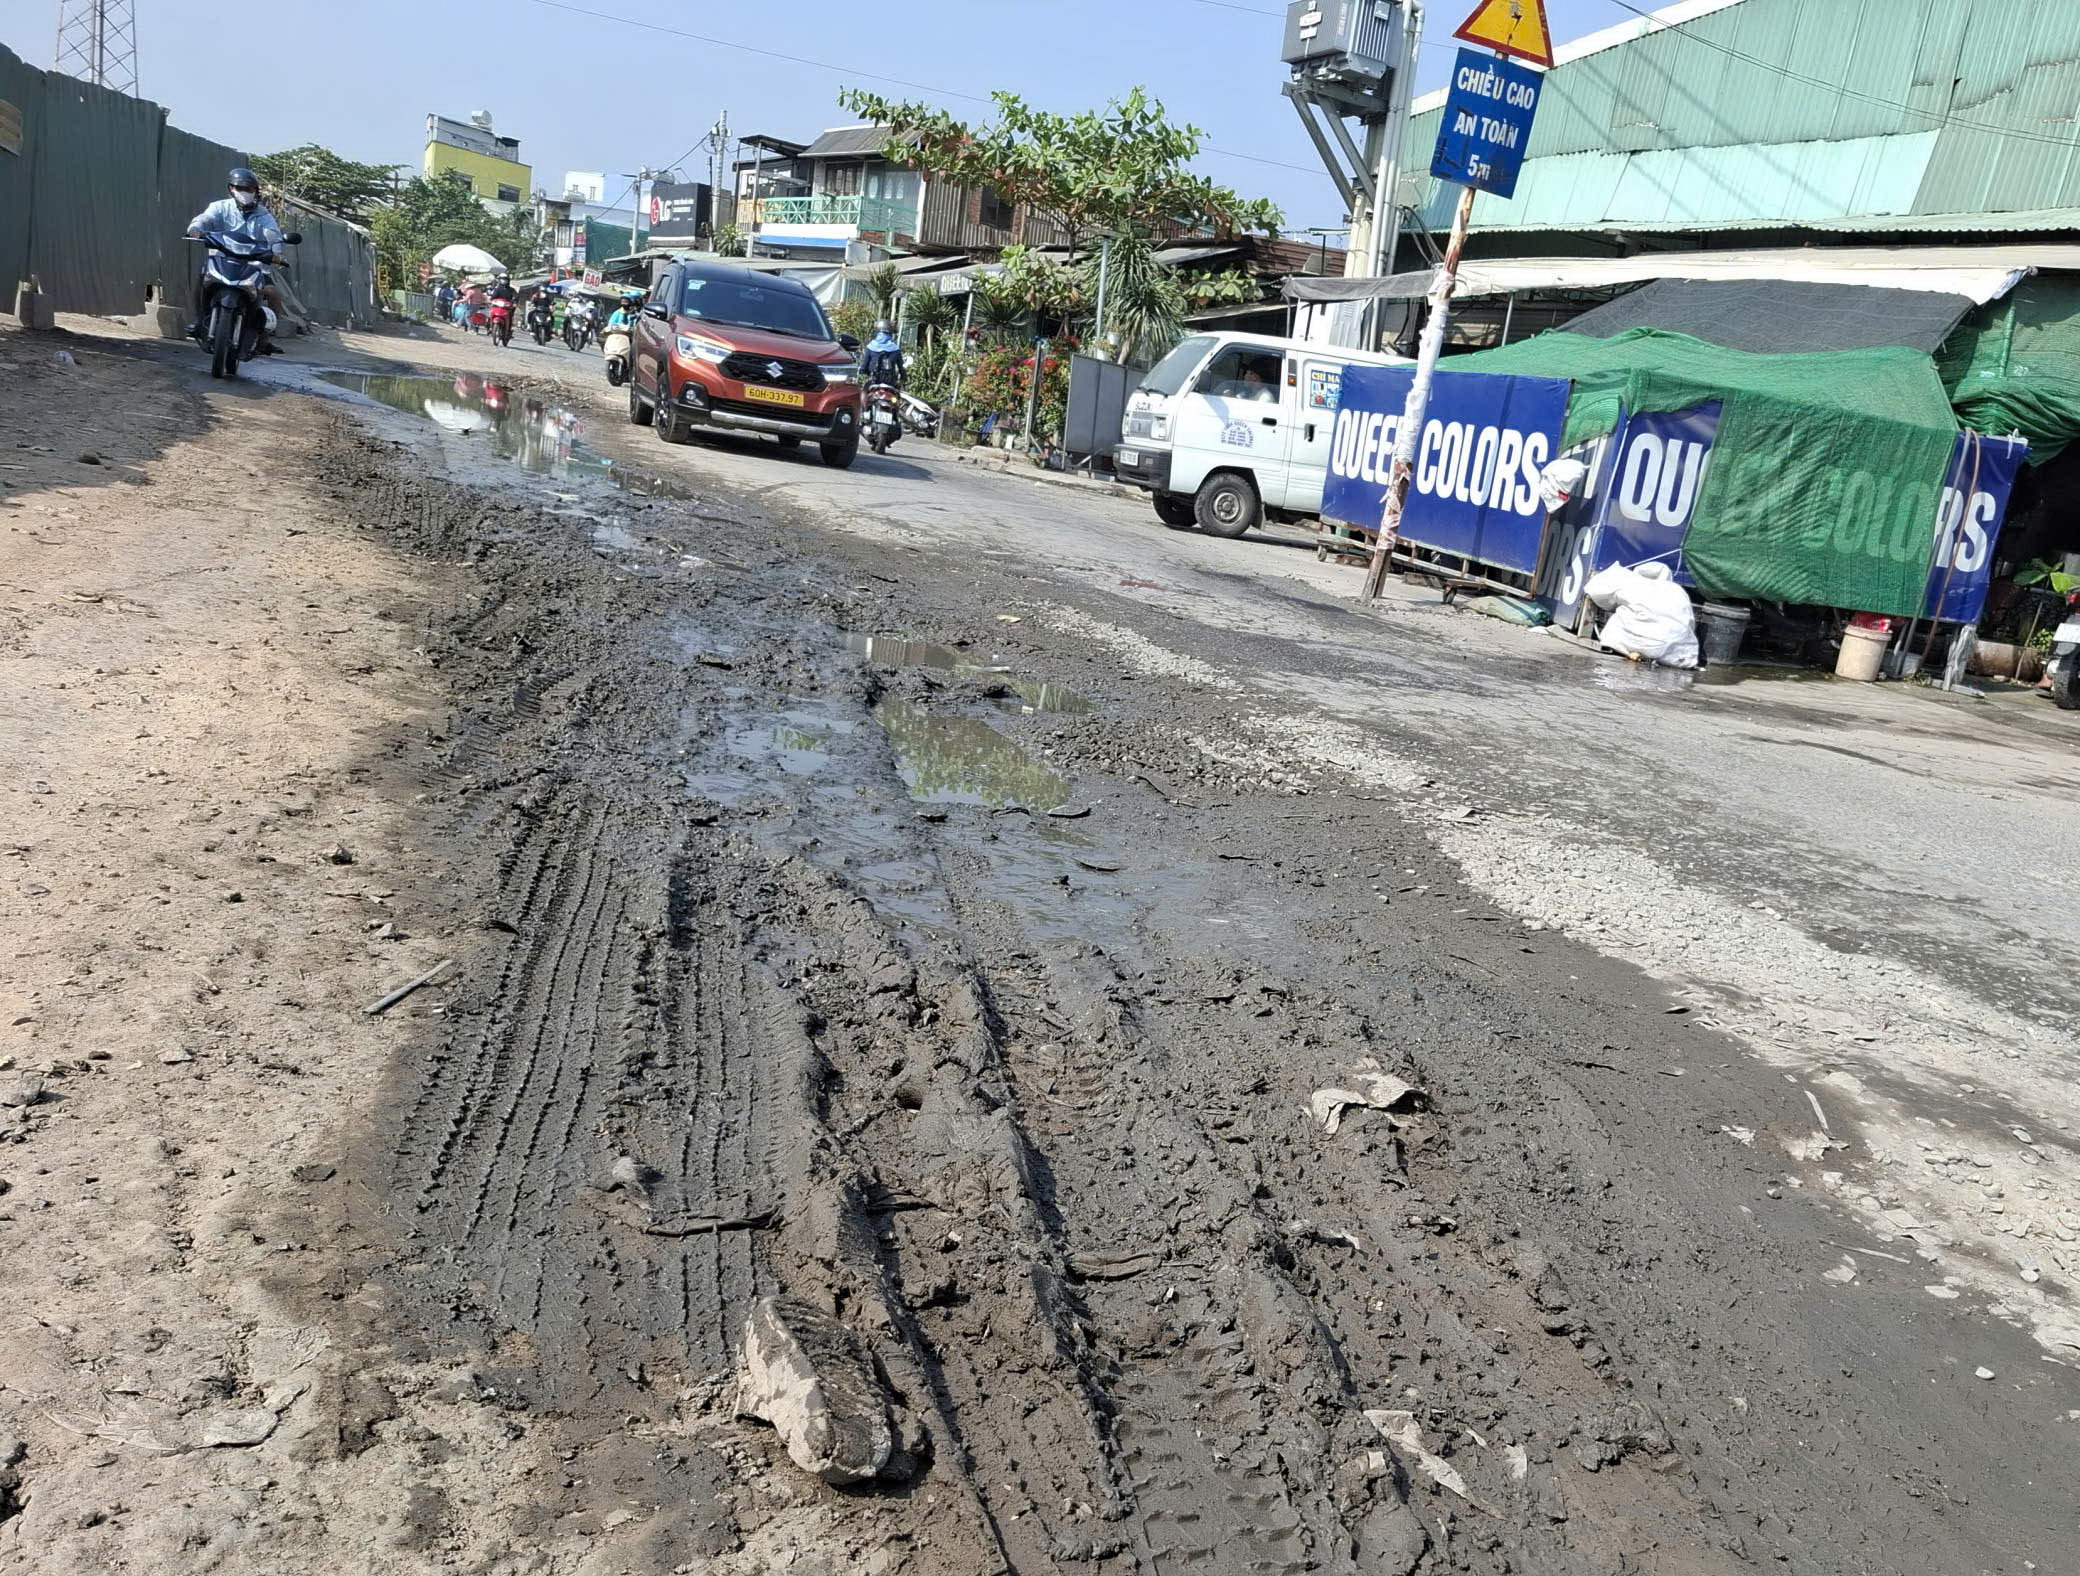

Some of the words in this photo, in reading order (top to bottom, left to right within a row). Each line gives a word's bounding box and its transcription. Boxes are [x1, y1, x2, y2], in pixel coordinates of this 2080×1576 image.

[1457, 63, 1505, 100] CHIỀU
[1506, 81, 1535, 110] CAO
[1453, 111, 1478, 137] AN
[1480, 117, 1520, 149] TOÀN
[1332, 408, 1405, 486] QUEE
[1416, 419, 1549, 517] COLORS
